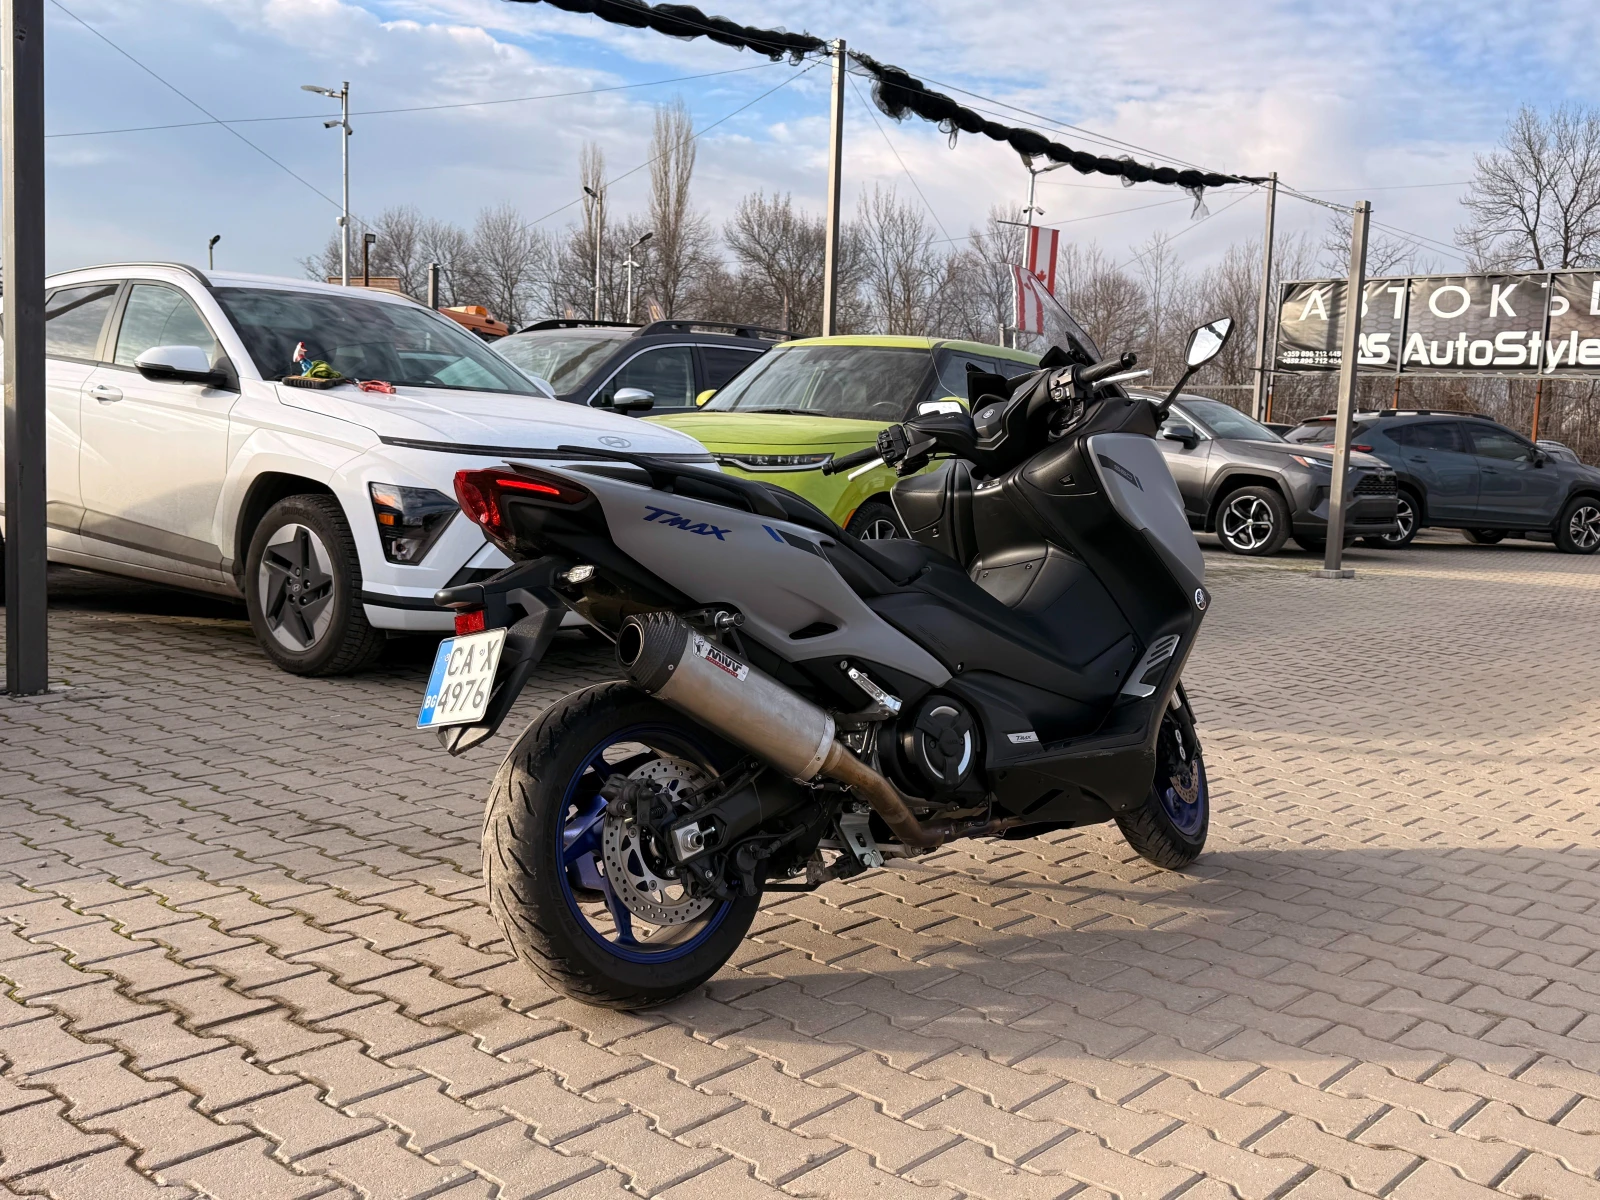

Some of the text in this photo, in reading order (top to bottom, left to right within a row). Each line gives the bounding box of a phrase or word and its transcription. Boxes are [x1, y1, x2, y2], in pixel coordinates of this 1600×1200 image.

[1402, 331, 1600, 373] AutoStyle
[643, 505, 732, 541] TMAX
[447, 639, 500, 677] CA X
[424, 694, 437, 708] BG
[437, 677, 487, 714] 4976
